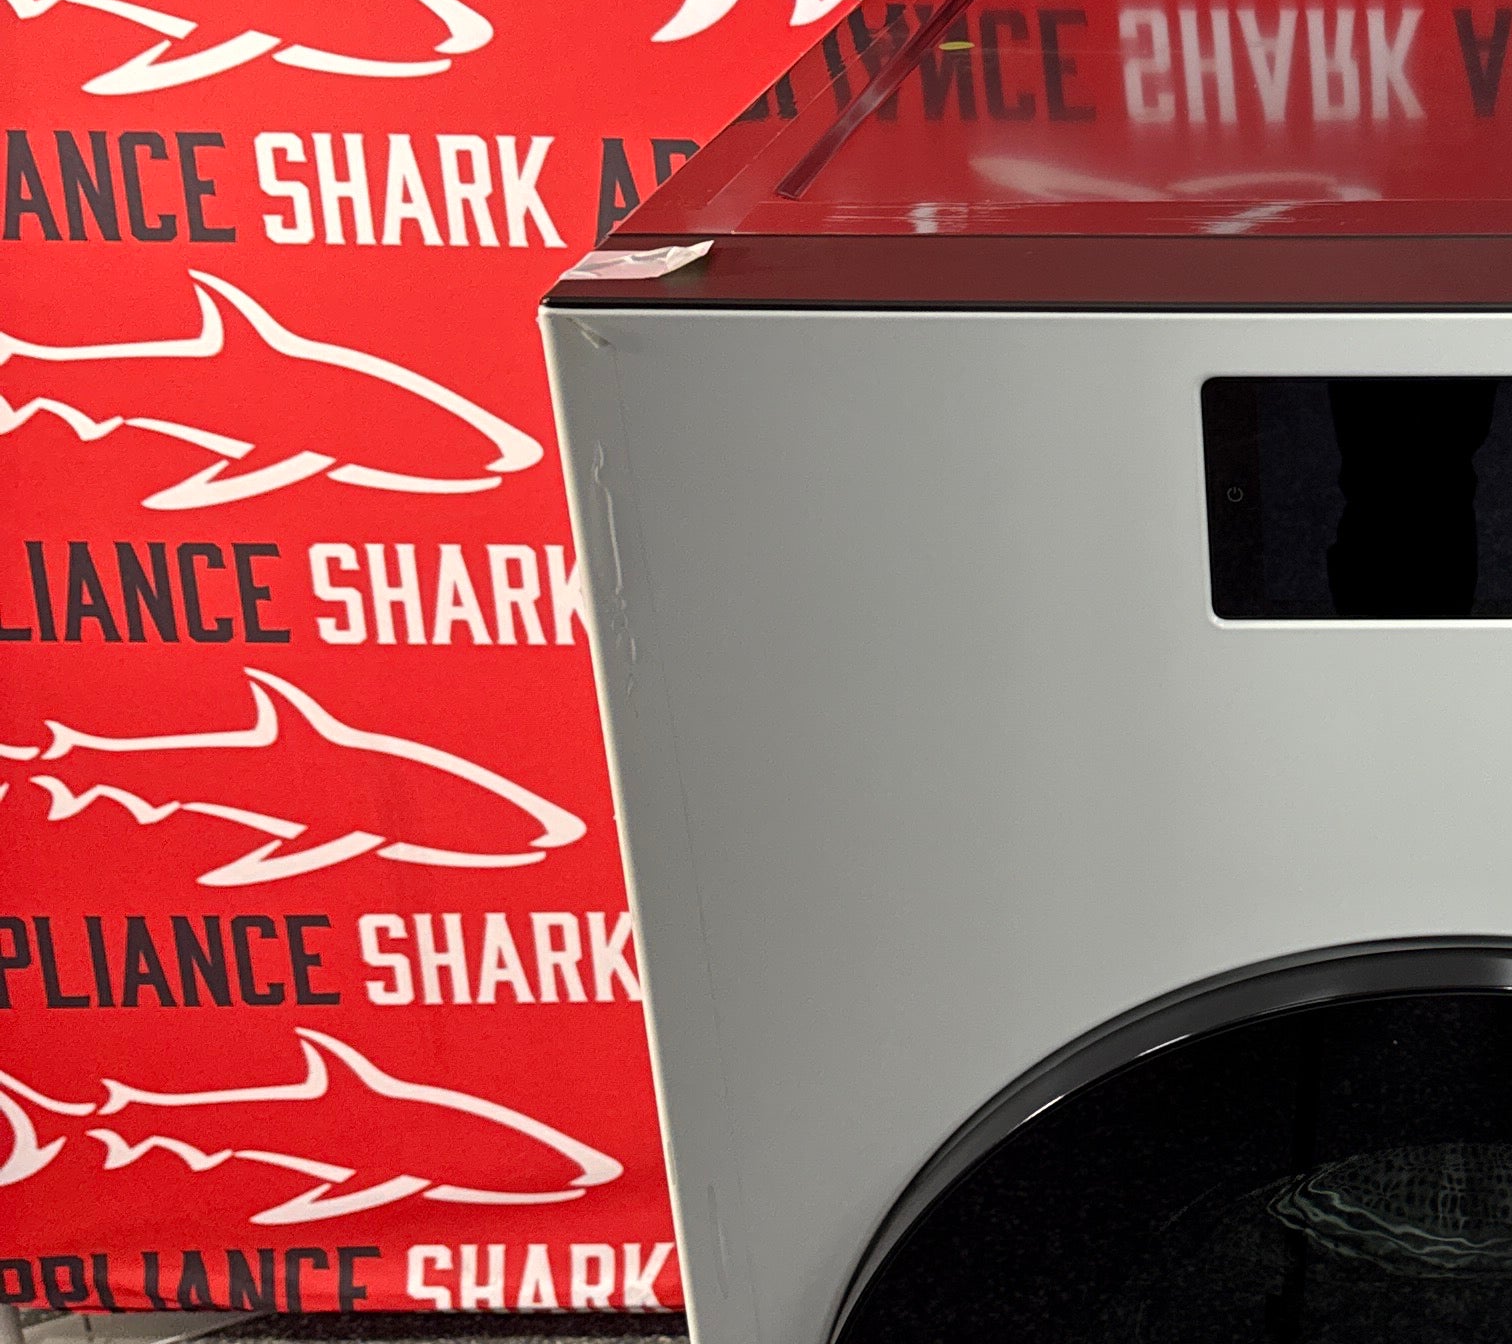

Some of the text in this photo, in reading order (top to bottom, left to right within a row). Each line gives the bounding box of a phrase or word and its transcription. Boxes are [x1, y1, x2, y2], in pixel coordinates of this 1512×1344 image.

[5, 131, 235, 241] ANCE
[254, 132, 566, 247] SHARK
[309, 543, 588, 645] SHARK
[359, 911, 642, 1005] SHARK
[407, 1243, 676, 1312] SHARK
